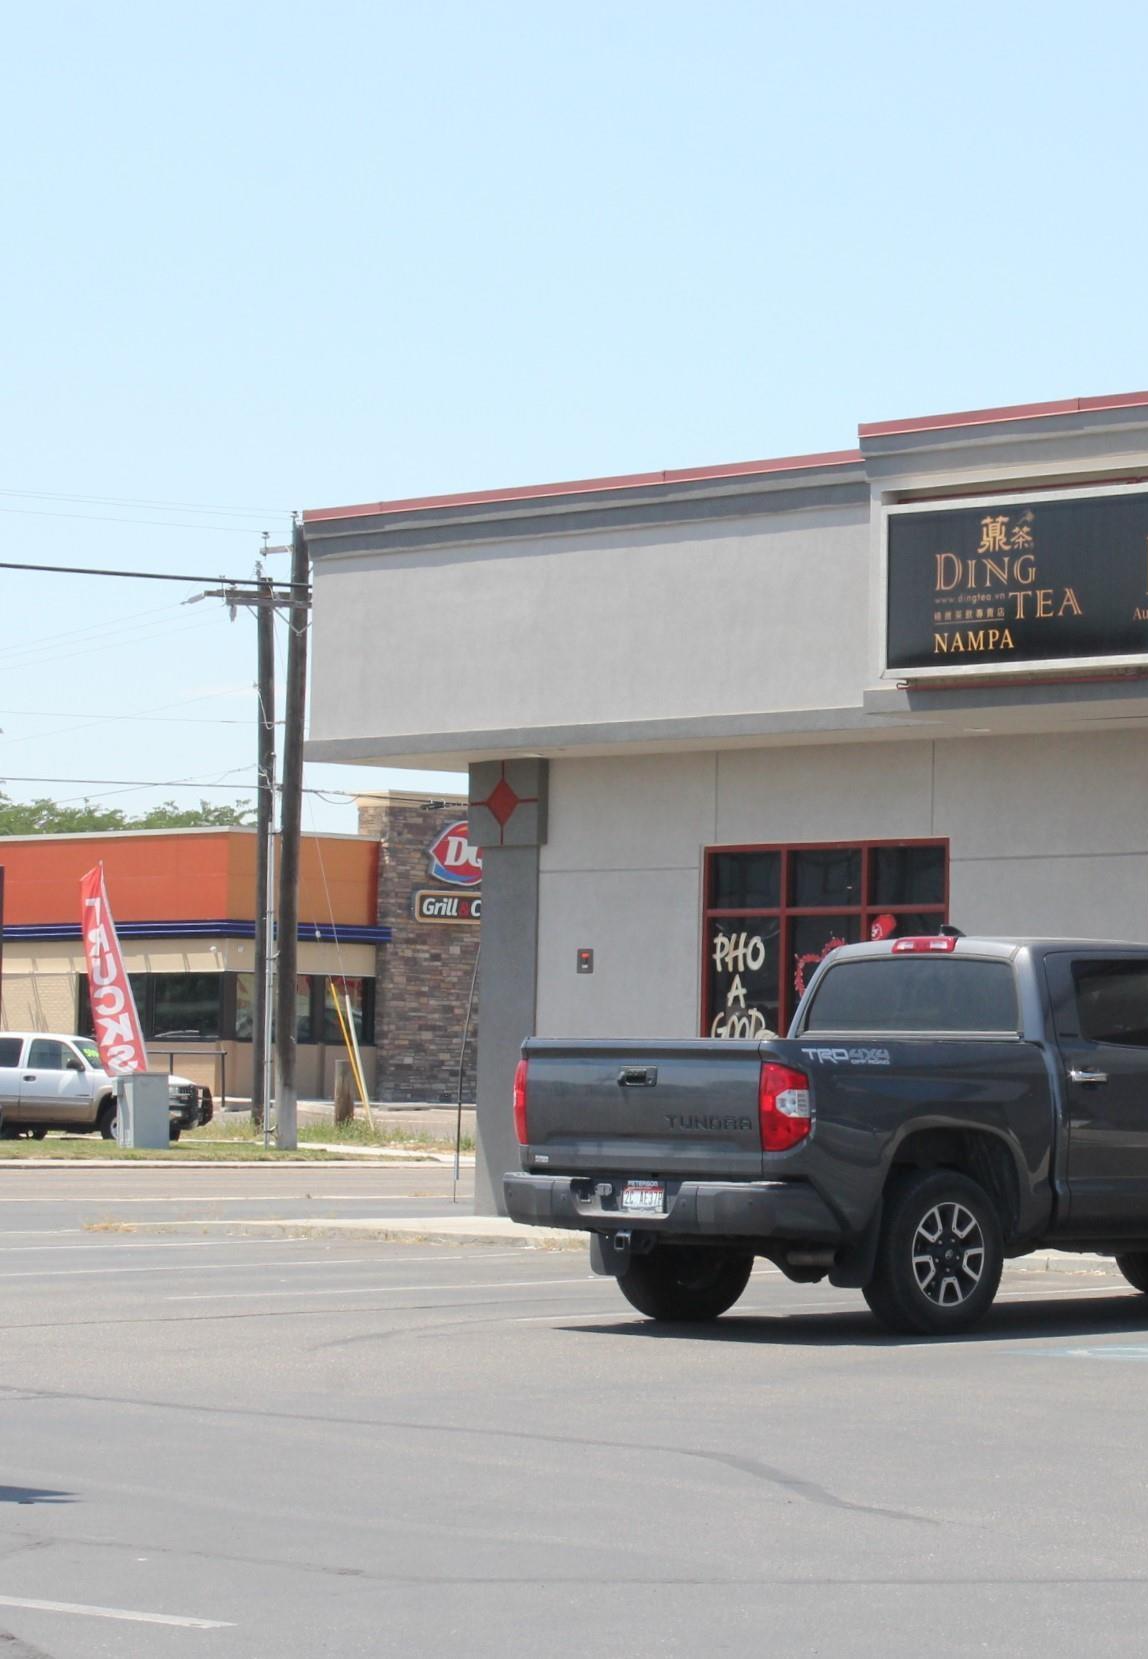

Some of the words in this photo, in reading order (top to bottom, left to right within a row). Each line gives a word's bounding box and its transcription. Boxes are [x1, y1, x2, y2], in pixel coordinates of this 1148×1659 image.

[935, 553, 1036, 591] DING
[1008, 588, 1083, 620] TEA
[934, 628, 1014, 653] NAMPA
[422, 898, 458, 916] Grill
[713, 932, 766, 972] PHO
[727, 974, 748, 1008] A
[801, 1048, 848, 1064] TRD
[665, 1113, 752, 1130] TUNDRA
